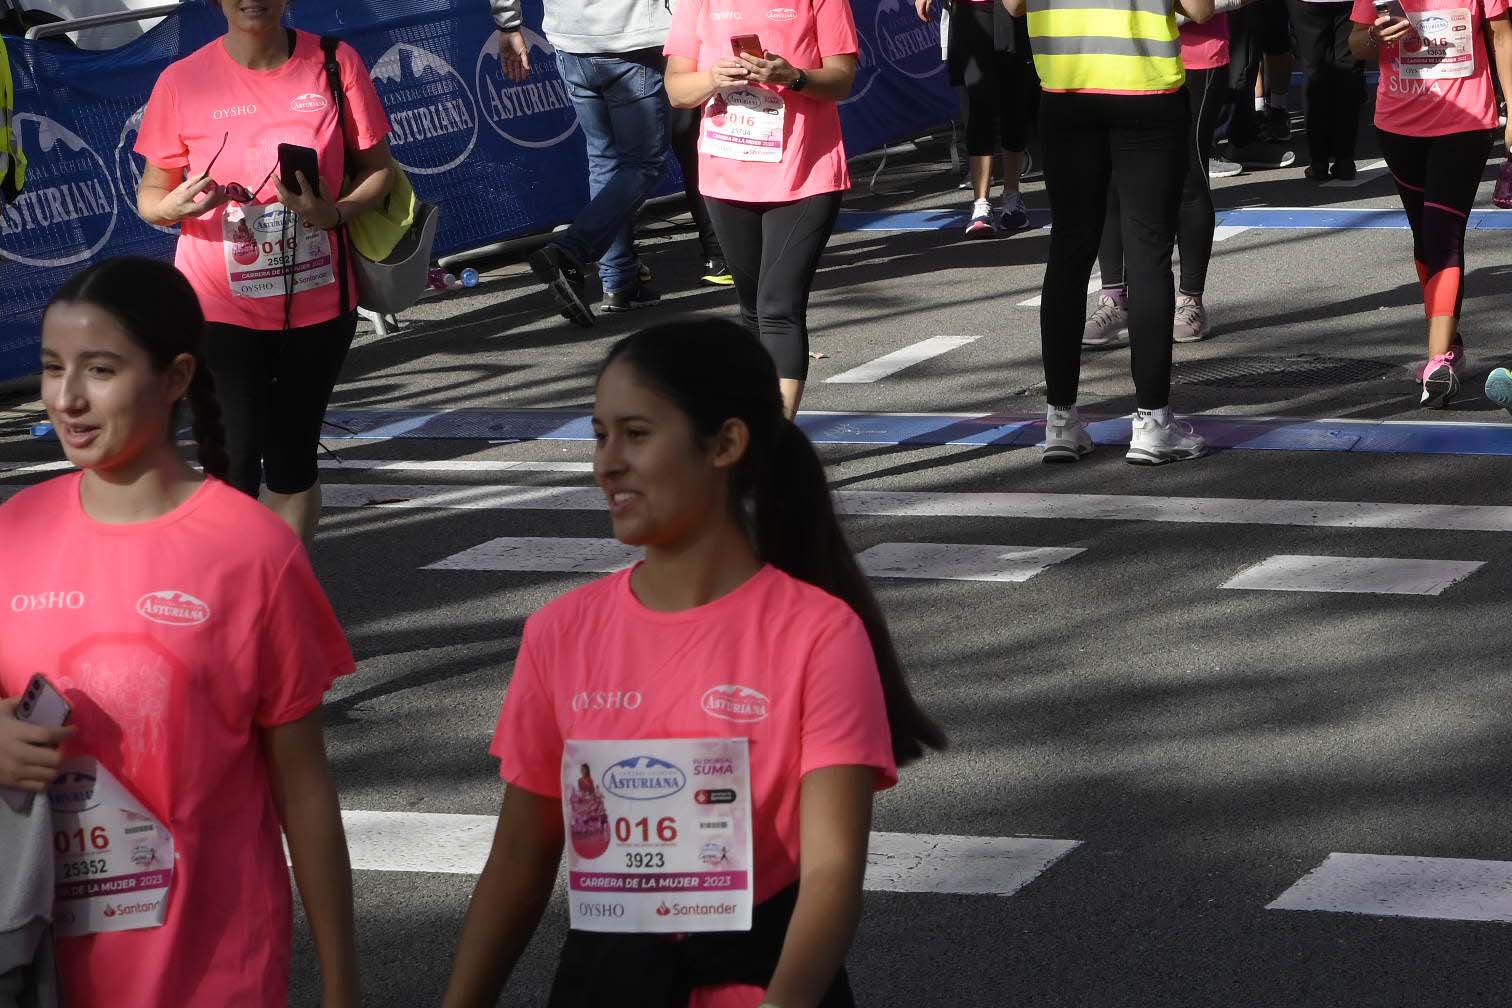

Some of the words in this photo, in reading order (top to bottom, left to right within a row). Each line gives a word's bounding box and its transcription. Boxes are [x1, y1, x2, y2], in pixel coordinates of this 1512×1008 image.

[1424, 37, 1448, 47] 016
[1389, 75, 1442, 95] SUMA
[213, 104, 257, 120] OYSHO
[730, 113, 755, 127] 016
[241, 271, 270, 279] CARRERA
[241, 283, 274, 293] OYSHO
[11, 591, 85, 613] OYSHO
[143, 601, 204, 620] ASTURIANA
[572, 691, 643, 713] OYSHO
[706, 695, 767, 716] ASTURIANA
[694, 765, 733, 776] SUMA
[608, 773, 679, 790] ASTURIANA
[615, 817, 677, 842] 016
[54, 826, 110, 854] 016
[626, 852, 665, 868] 3923
[64, 859, 108, 879] 25352
[88, 884, 99, 893] LA
[101, 878, 136, 892] MUJER
[140, 874, 163, 886] 2023
[580, 877, 624, 888] CARRERA
[625, 878, 640, 888] DE
[641, 878, 656, 888] LA
[658, 877, 699, 888] MUJER
[703, 876, 731, 887] 2023
[579, 902, 625, 918] OYSHO
[673, 902, 737, 916] Santander
